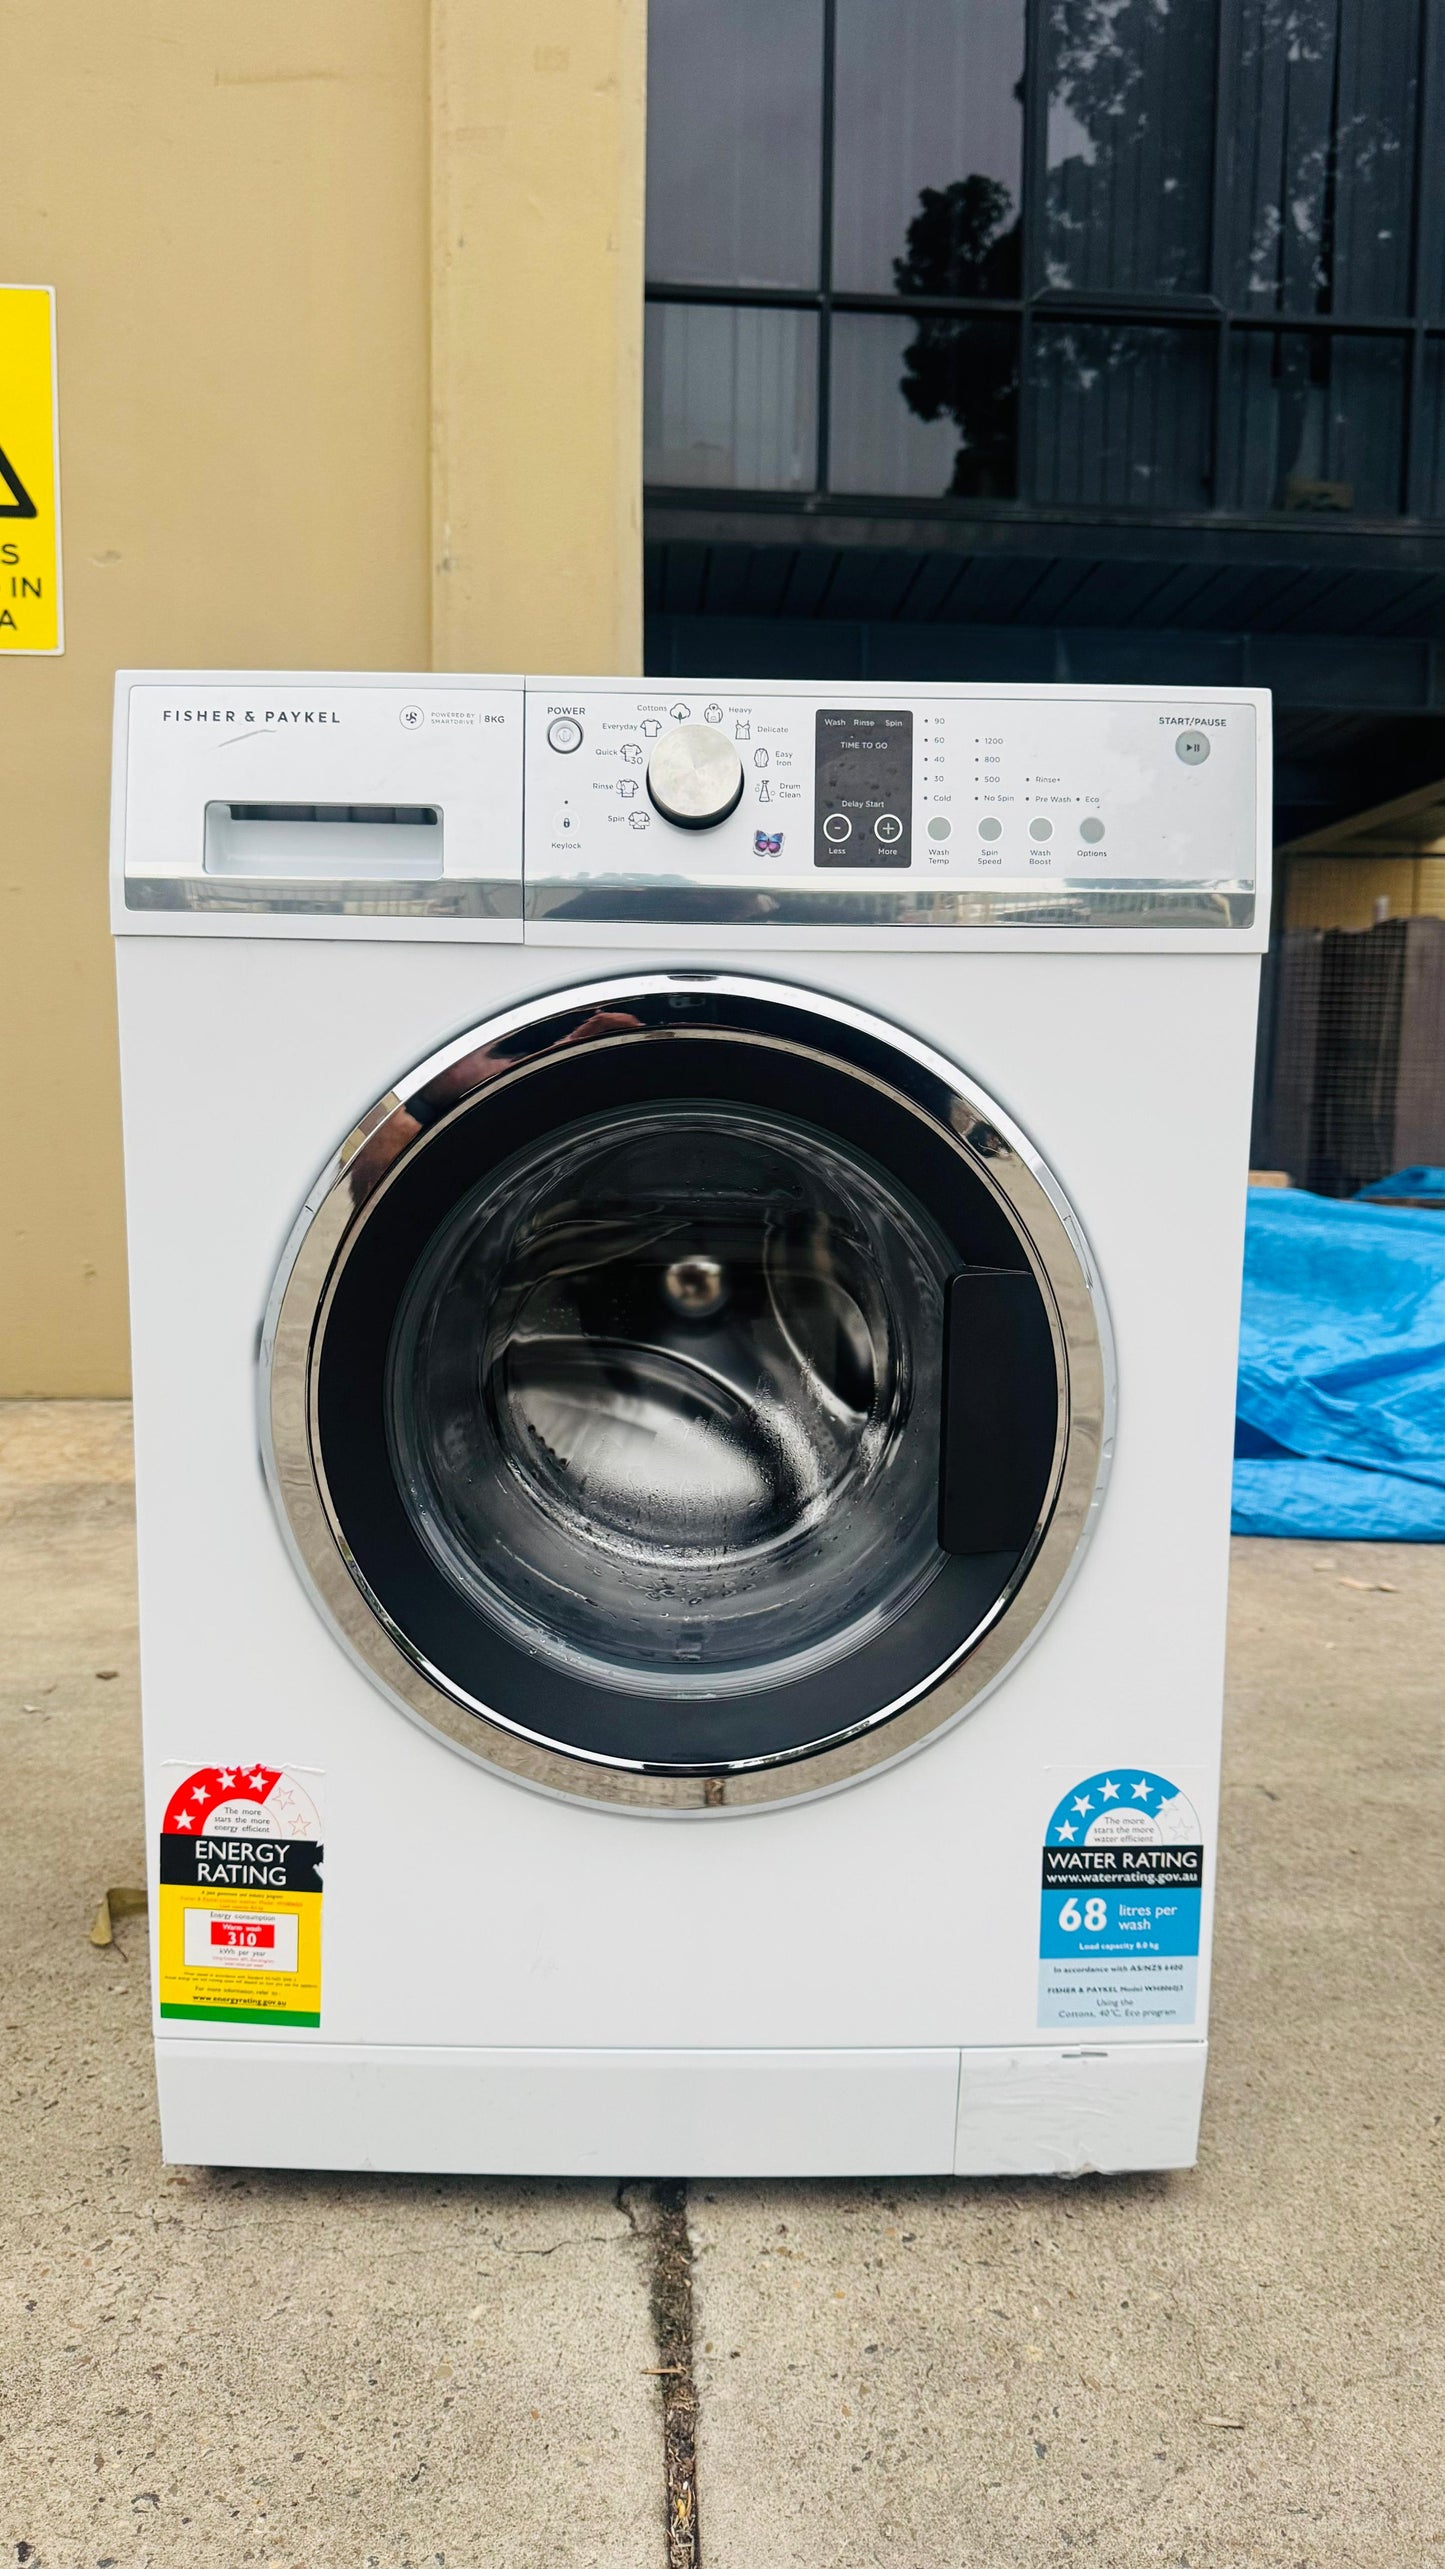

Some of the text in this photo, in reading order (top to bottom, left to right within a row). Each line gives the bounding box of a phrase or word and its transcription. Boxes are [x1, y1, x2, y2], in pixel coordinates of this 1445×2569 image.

[12, 577, 41, 598] IN
[547, 706, 586, 716] POWER
[636, 704, 668, 712] Cottons
[728, 706, 753, 715] Heavy
[163, 710, 341, 724] FISHER & PAYKEL
[484, 714, 505, 724] 8KG
[934, 717, 946, 725] 90
[1158, 716, 1227, 727] START/PAUSE
[602, 722, 638, 732] Everyday
[824, 718, 903, 728] Wash Rinse Spin
[757, 725, 789, 734] Delicate
[933, 736, 945, 744] 60
[984, 737, 1004, 745] 1200
[840, 741, 889, 750] TIME TO GO
[595, 748, 618, 756] Quick
[775, 750, 793, 759] Easy
[629, 755, 644, 765] 30
[933, 755, 945, 764] 40
[984, 756, 1001, 764] 800
[933, 775, 945, 783] 30
[984, 775, 1001, 784] 500
[592, 782, 614, 790] Rinse
[779, 782, 801, 790] Drum
[778, 791, 802, 799] Clean
[933, 794, 952, 802] Cold
[983, 794, 1015, 803] No Spin
[1035, 795, 1072, 803] Pre Wash
[1084, 795, 1101, 804] Eco
[841, 798, 885, 809] Delay Start
[607, 815, 625, 823] Spin
[551, 841, 582, 850] Keylock
[828, 847, 847, 855] Less
[877, 847, 898, 856] More
[928, 848, 950, 856] Wash
[980, 848, 1000, 857] Spin
[1029, 849, 1052, 857] Wash
[1076, 849, 1108, 858] Options
[928, 857, 950, 865] Temp
[977, 857, 1002, 866] Speed
[1028, 857, 1052, 865] Boost
[223, 1806, 239, 1815] The
[214, 1816, 271, 1826] stars the more
[1103, 1816, 1146, 1826] The more
[213, 1824, 270, 1834] energy efficient
[1093, 1827, 1115, 1835] stars
[1115, 1825, 1130, 1835] the
[1119, 1834, 1154, 1843] efficient
[195, 1840, 291, 1863] ENERGY
[1048, 1852, 1197, 1869] WATER RATING
[197, 1863, 287, 1886] RATING
[1047, 1871, 1197, 1884] www.waterrating.gov.au
[1059, 1898, 1107, 1931] 68
[1119, 1904, 1177, 1918] litres per
[210, 1911, 276, 1922] Energy consumption
[222, 1922, 262, 1932] Warm wash
[1119, 1918, 1151, 1930] wash
[227, 1932, 257, 1947] 310
[1078, 1942, 1100, 1951] Load
[1100, 1942, 1135, 1951] capacity
[1149, 1941, 1160, 1951] kg
[218, 1947, 237, 1955] kWh
[1053, 1966, 1063, 1974] In
[1063, 1965, 1109, 1974] accordance
[1110, 1965, 1129, 1973] with
[1120, 1998, 1134, 2007] the
[1124, 2008, 1141, 2017] Eco
[1142, 2009, 1177, 2018] program
